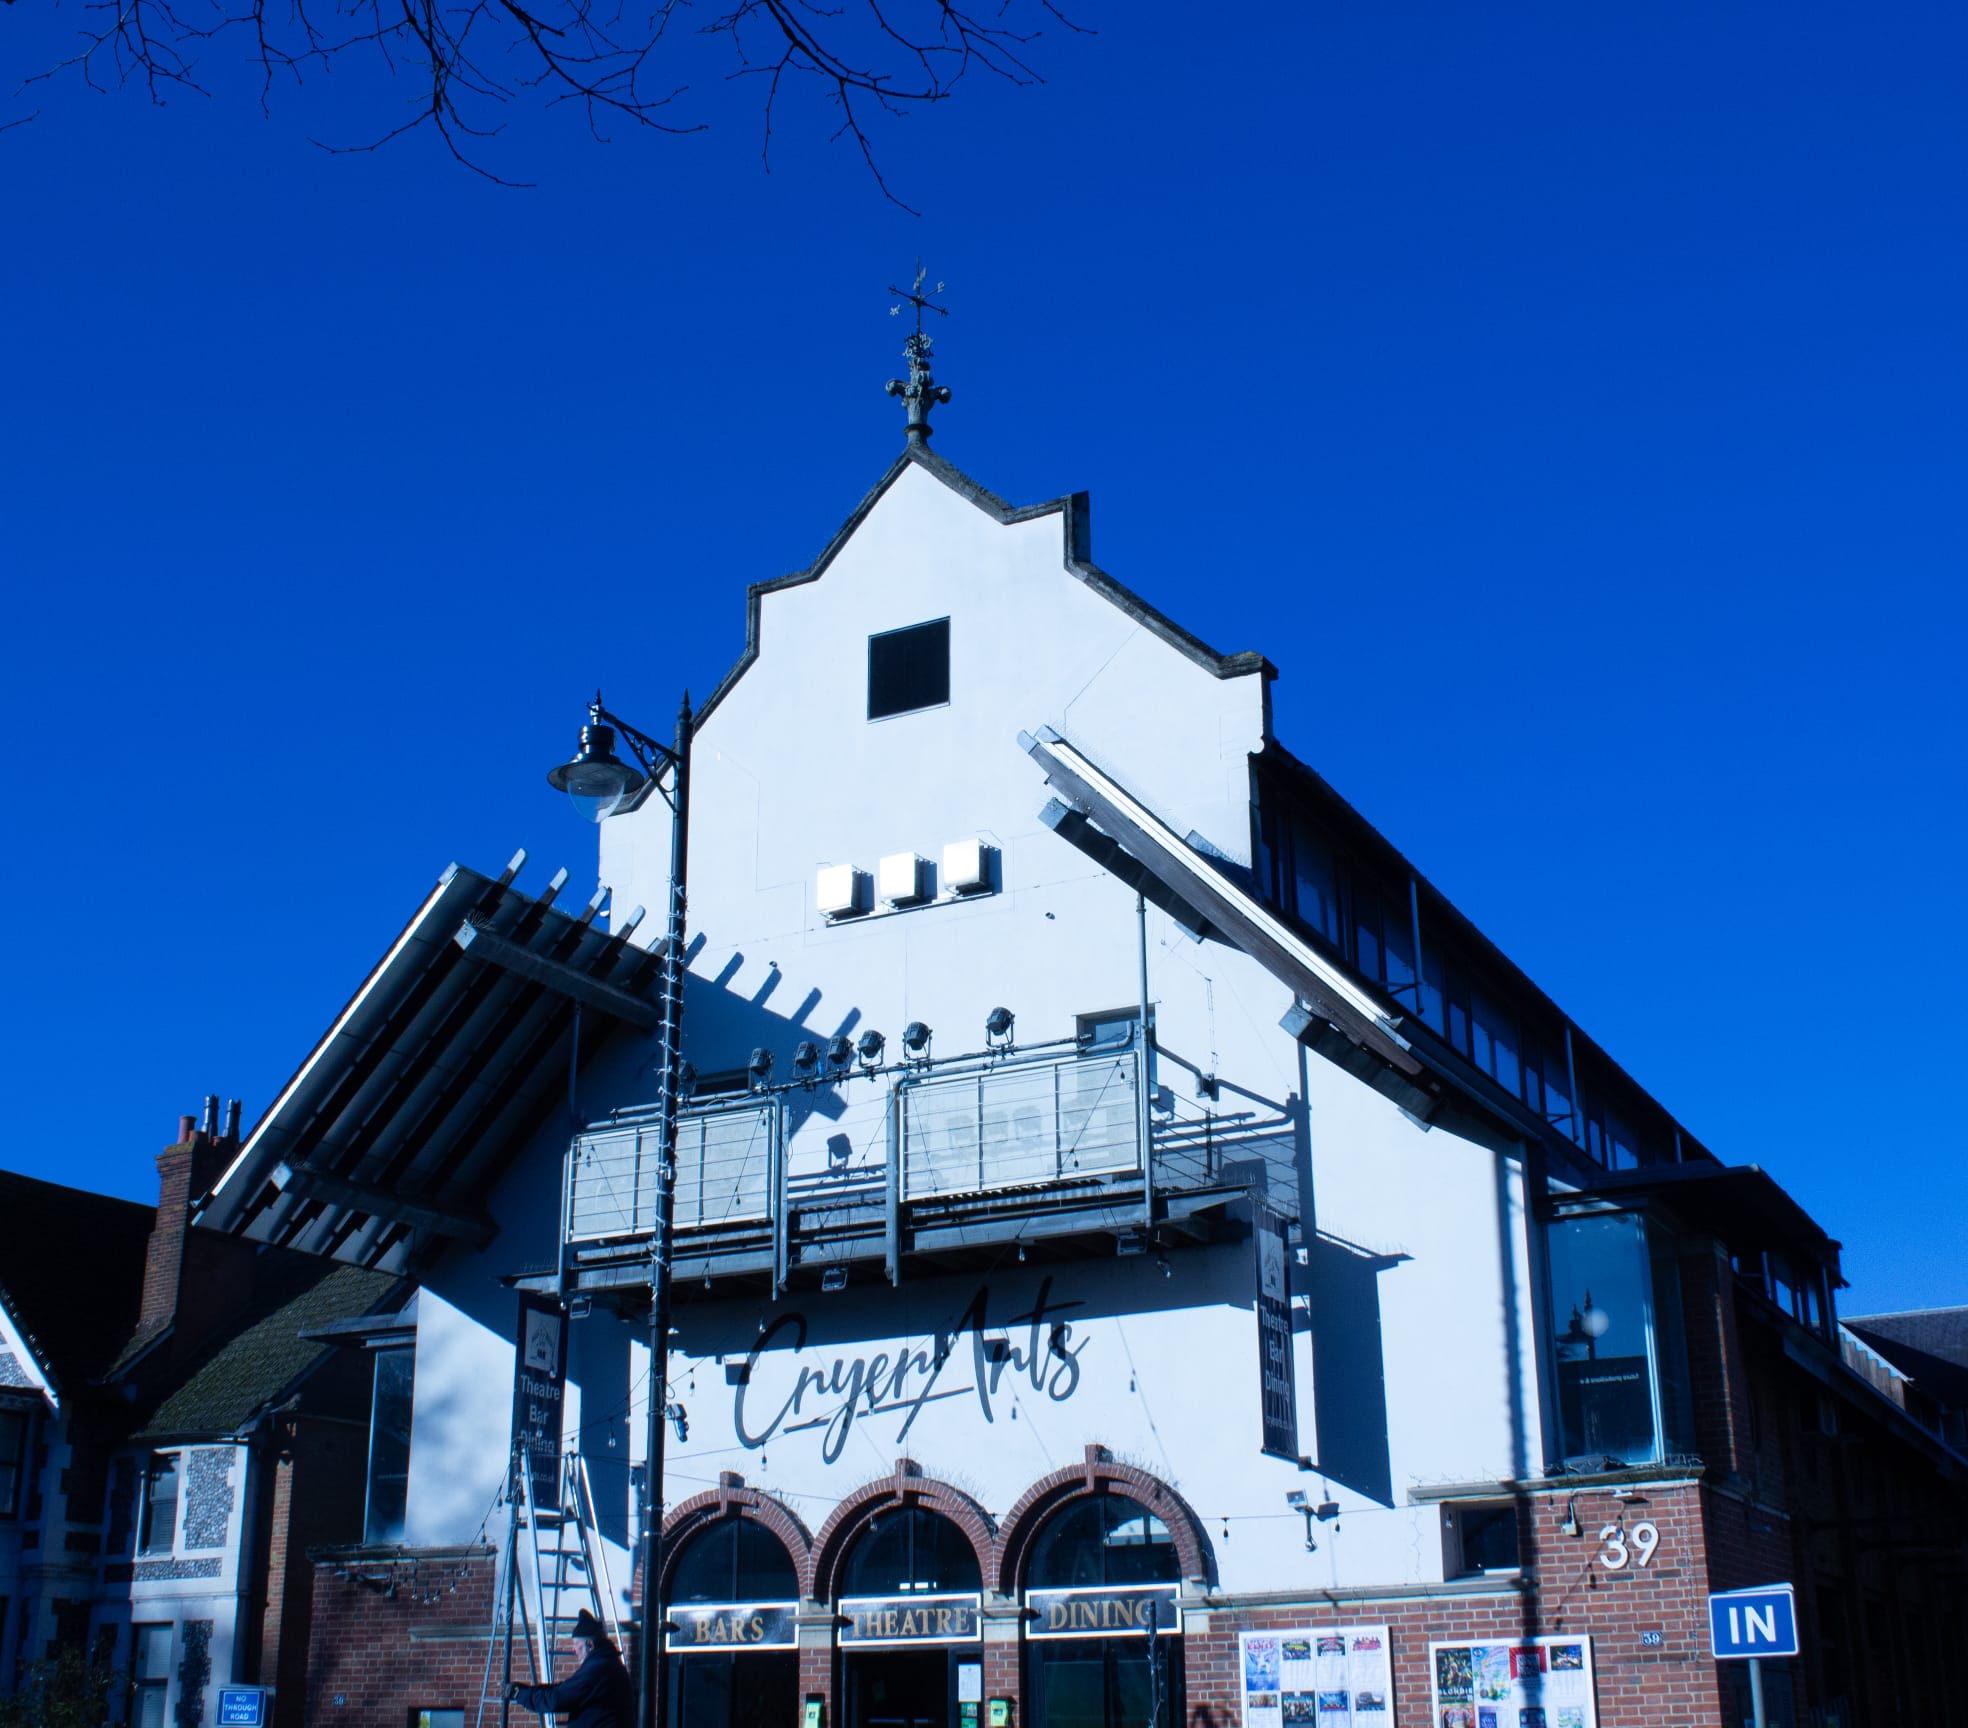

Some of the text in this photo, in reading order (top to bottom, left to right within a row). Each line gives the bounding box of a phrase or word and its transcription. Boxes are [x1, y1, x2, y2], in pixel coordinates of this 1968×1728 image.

[1260, 1304, 1288, 1335] Theatre
[1269, 1340, 1283, 1363] Bar
[520, 1374, 560, 1400] Theatre
[1265, 1369, 1289, 1401] Dining
[529, 1404, 548, 1424] Bar
[519, 1430, 556, 1455] Dining
[1599, 1522, 1659, 1569] 39
[693, 1616, 764, 1643] BARS
[847, 1606, 969, 1637] THEATRE
[1728, 1605, 1776, 1645] IN
[225, 1703, 257, 1712] THROUGH
[230, 1712, 249, 1721] ROAD
